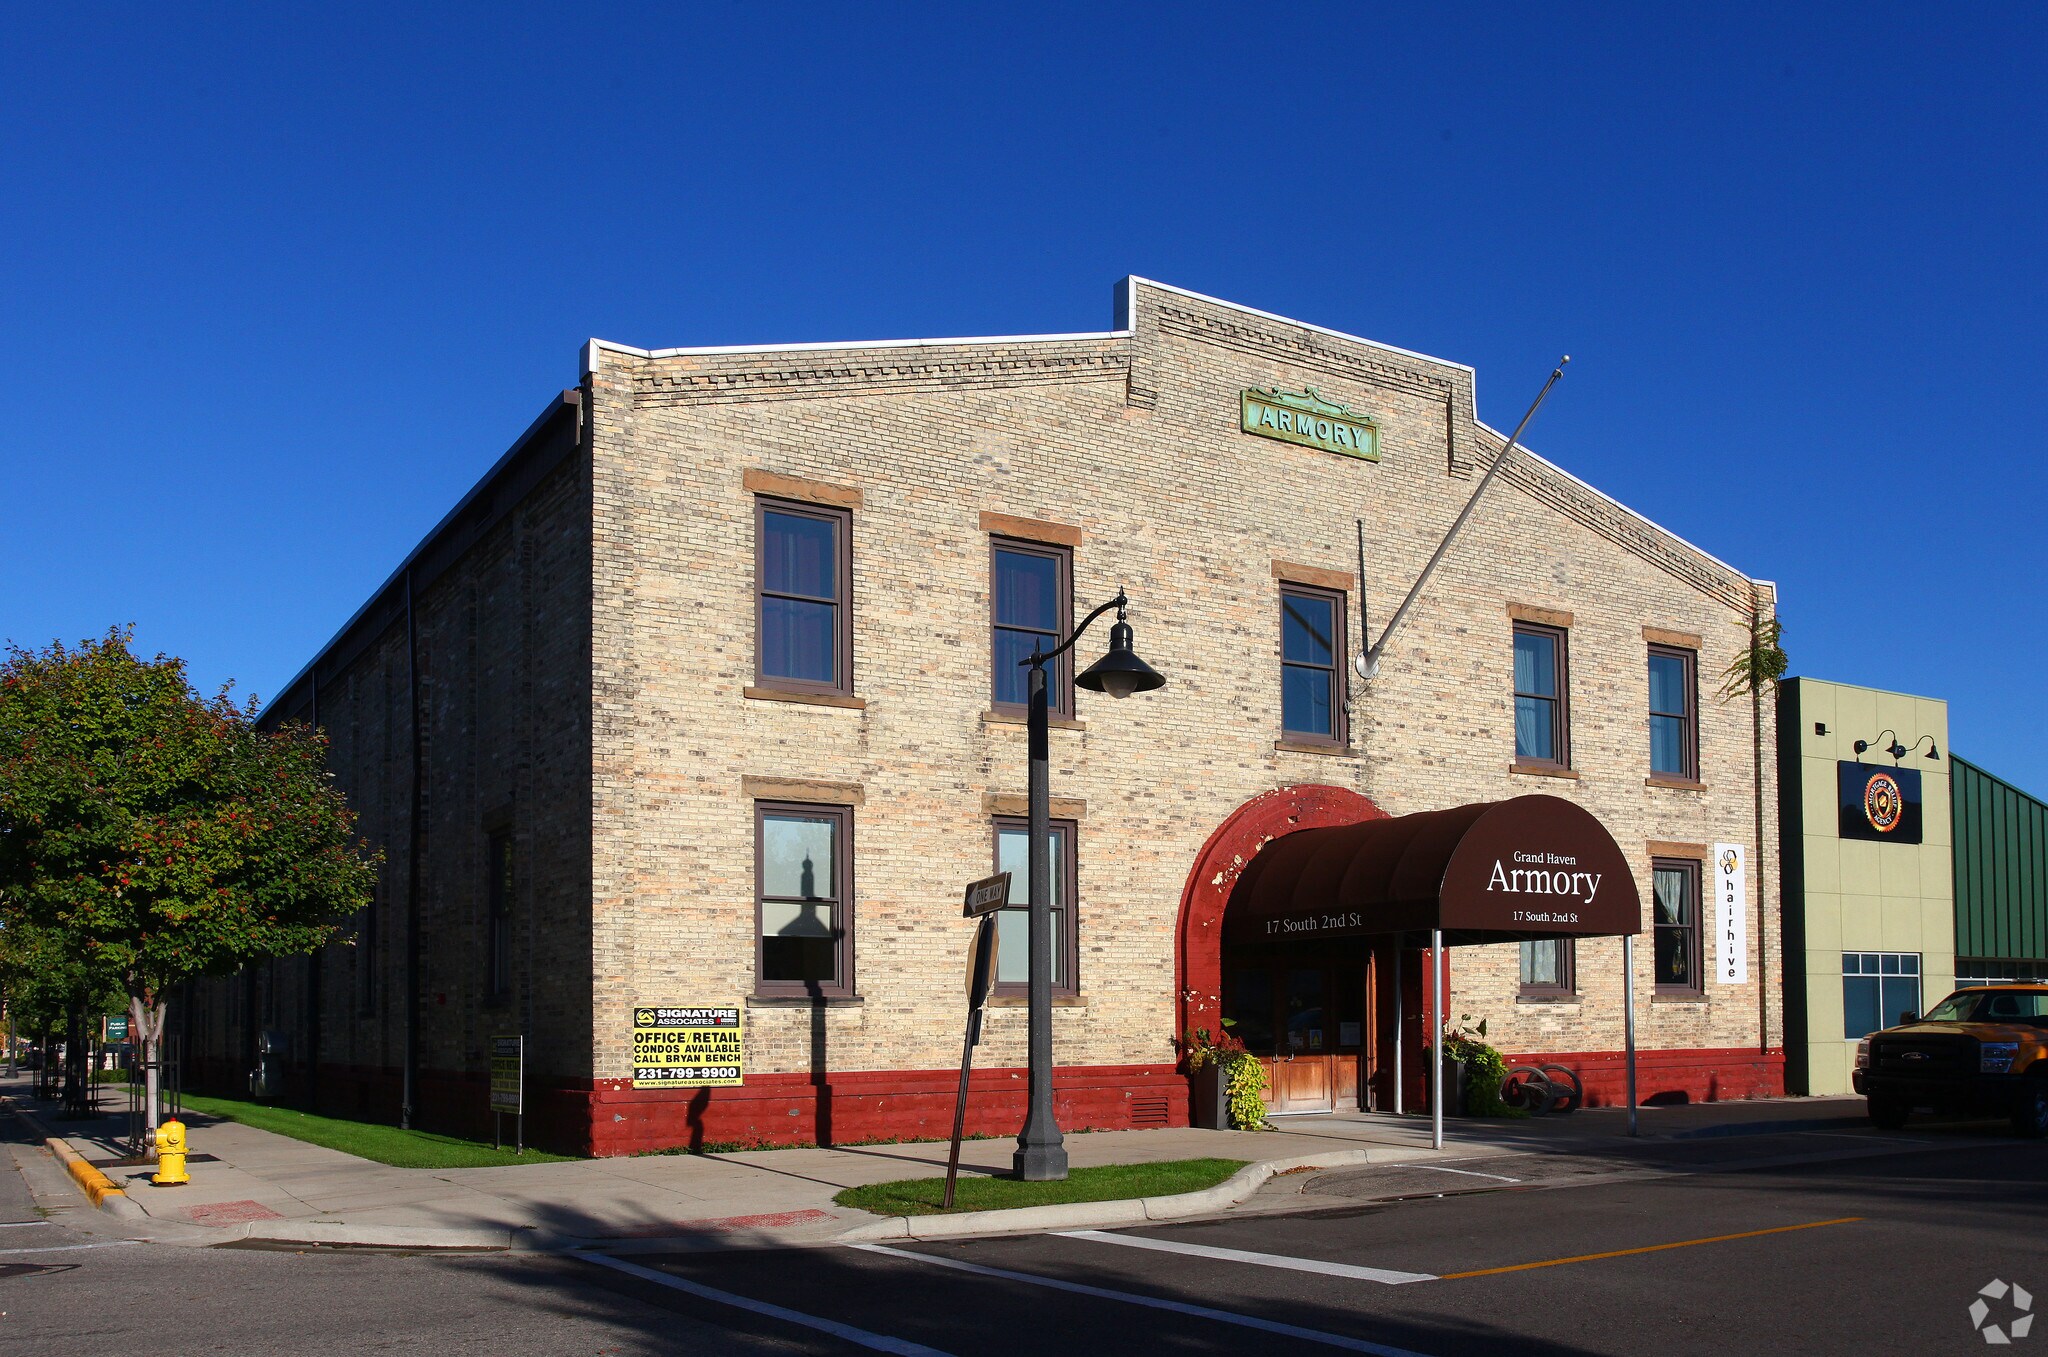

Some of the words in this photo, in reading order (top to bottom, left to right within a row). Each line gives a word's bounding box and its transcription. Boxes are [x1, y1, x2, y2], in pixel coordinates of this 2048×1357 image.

[1260, 406, 1363, 448] ARMORY
[1513, 850, 1544, 863] Grand
[1546, 853, 1577, 865] Haven
[1486, 859, 1602, 904] Armory
[976, 890, 988, 904] ONE
[990, 885, 1002, 900] WAY
[1266, 920, 1280, 934] 17
[1283, 916, 1317, 933] South
[1321, 913, 1346, 929] 2nd
[1349, 912, 1362, 927] St
[1513, 911, 1524, 921] 17
[1525, 911, 1550, 922] South
[1552, 912, 1568, 922] 2nd
[1570, 913, 1579, 923] St
[1726, 880, 1736, 977] hairhive
[657, 1009, 737, 1018] SIGNATURE
[634, 1032, 740, 1043] OFFICE/RETAIL
[634, 1045, 680, 1054] CONDOS
[684, 1044, 741, 1053] AVAILABLE
[634, 1054, 661, 1063] CALL
[665, 1054, 701, 1063] BRYAN
[705, 1053, 741, 1062] BENCH
[638, 1067, 737, 1079] 231-799-9900
